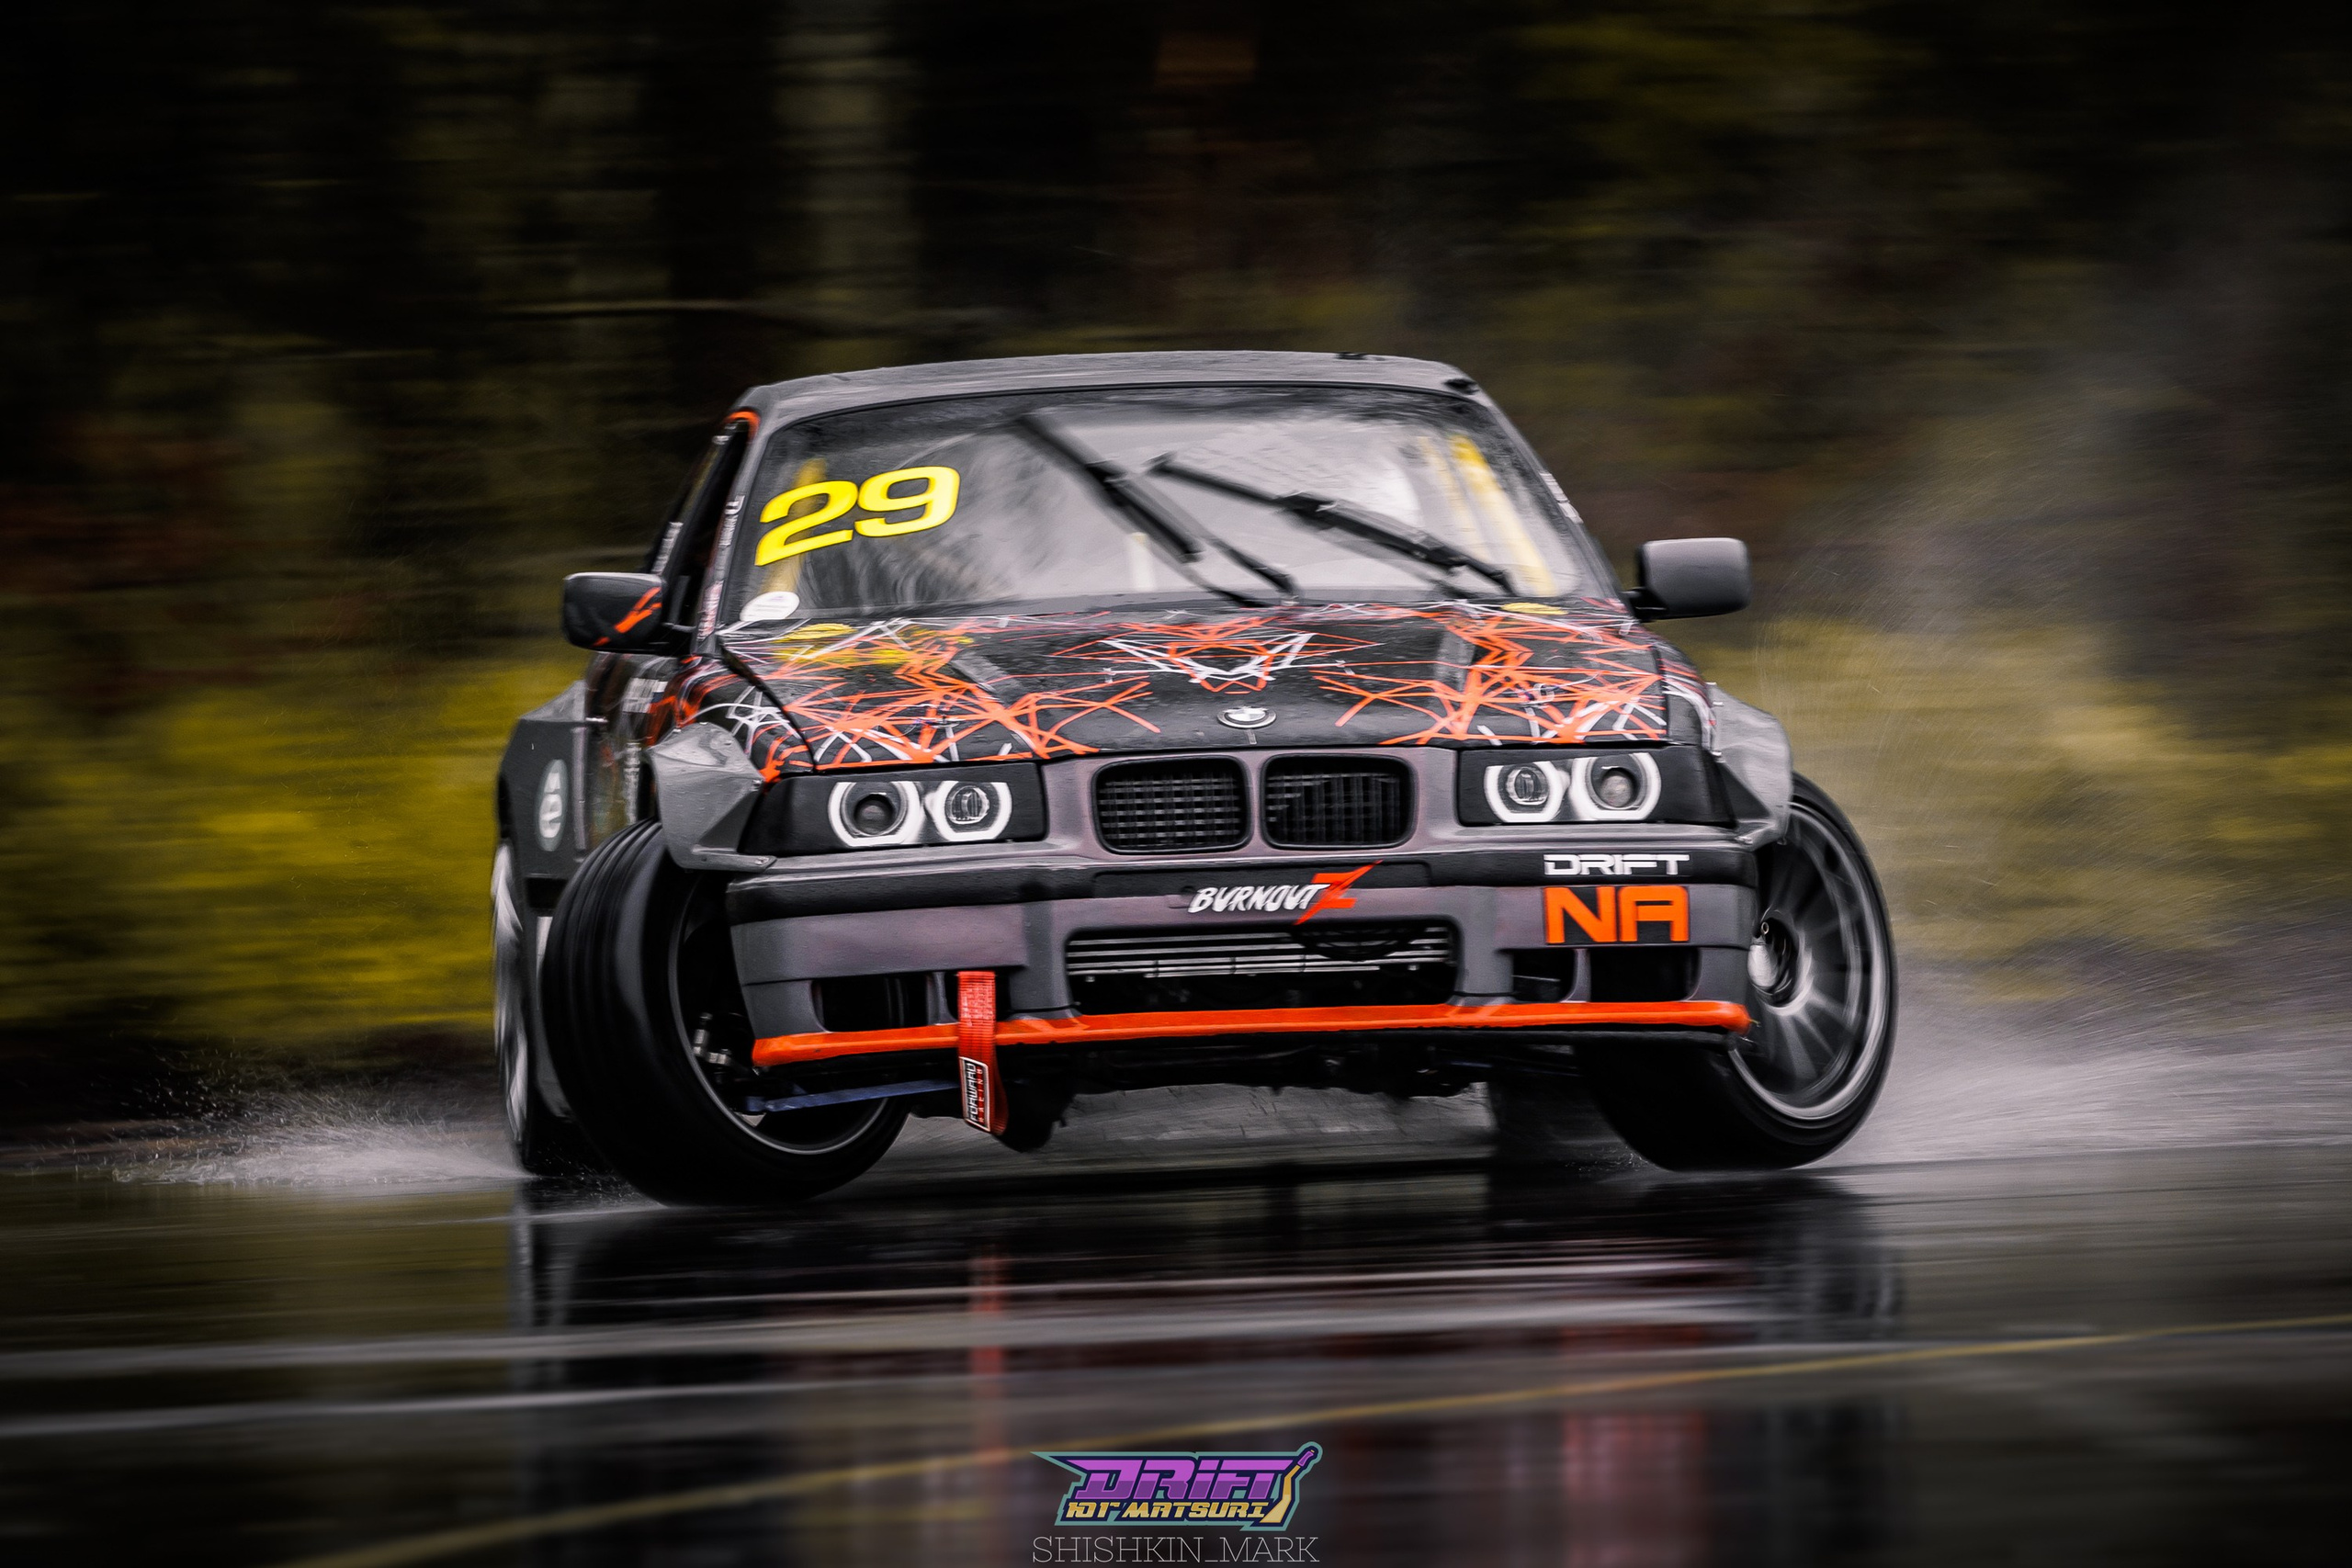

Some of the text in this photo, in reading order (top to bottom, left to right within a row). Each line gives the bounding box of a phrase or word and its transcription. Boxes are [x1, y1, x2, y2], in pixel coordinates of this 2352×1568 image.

[754, 466, 960, 566] 29
[1544, 854, 1690, 875] DRIFT
[1544, 886, 1690, 943] NA
[966, 1062, 978, 1122] FORWARD
